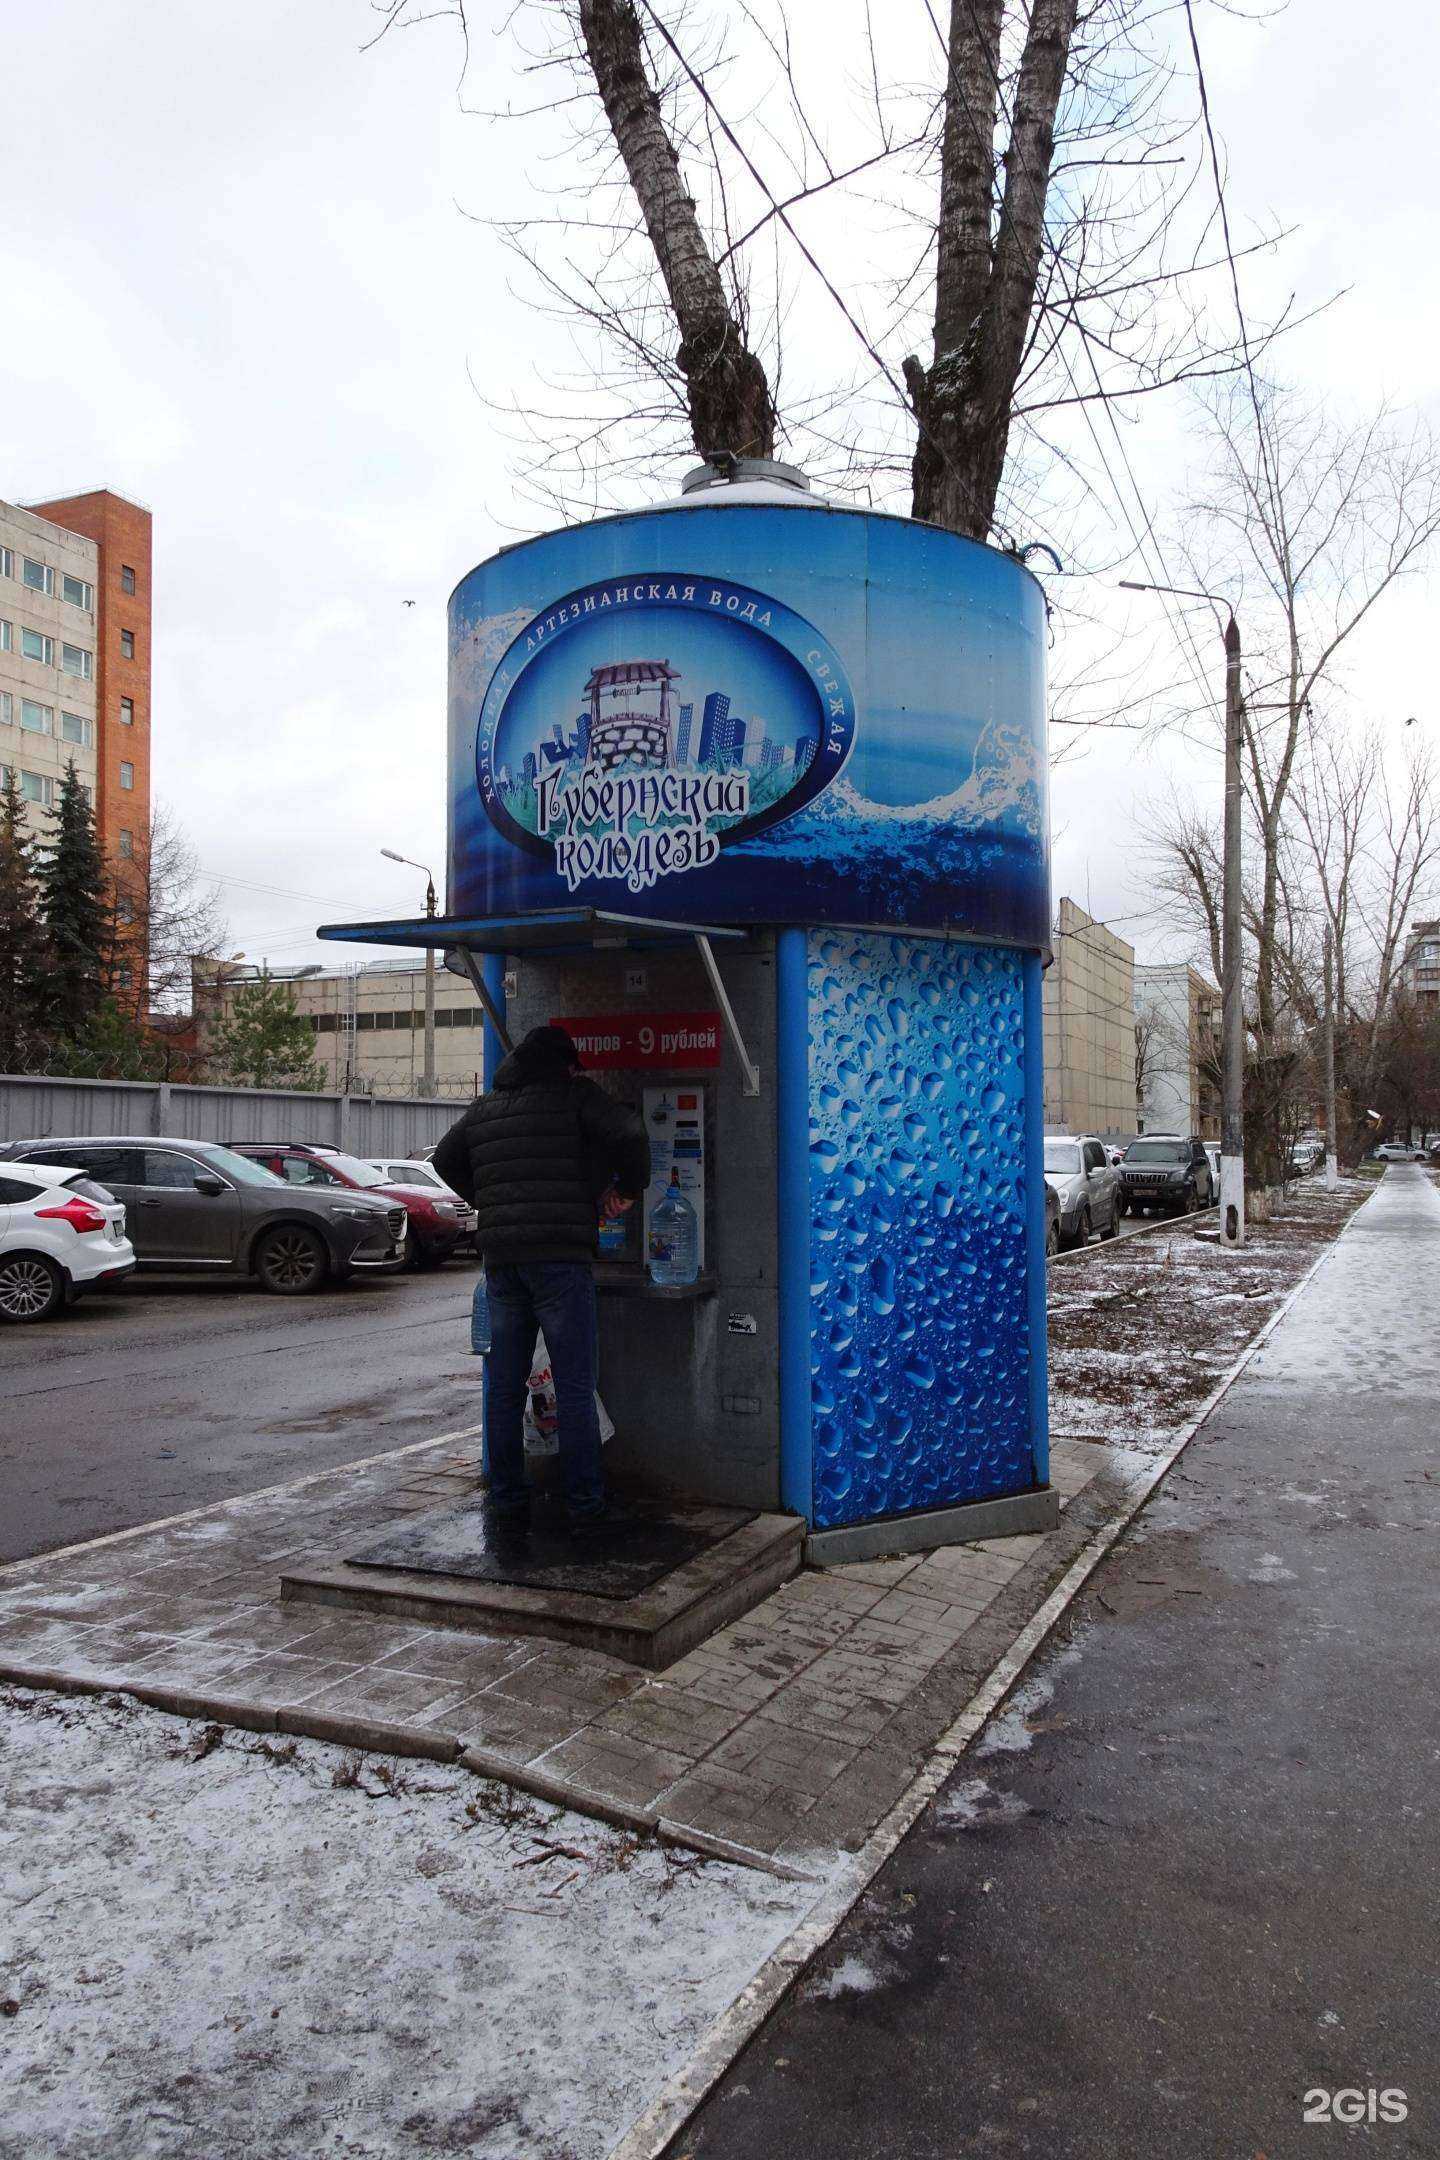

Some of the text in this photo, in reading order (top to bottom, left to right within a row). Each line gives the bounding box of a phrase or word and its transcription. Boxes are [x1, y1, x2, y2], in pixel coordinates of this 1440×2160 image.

[525, 584, 773, 651] АРТЕЗИАНСКАЯ ВОДА
[807, 650, 846, 755] СВЕЖАЯ
[534, 767, 748, 834] Губернский
[638, 1026, 655, 1054] 9
[661, 1025, 716, 1054] рублей
